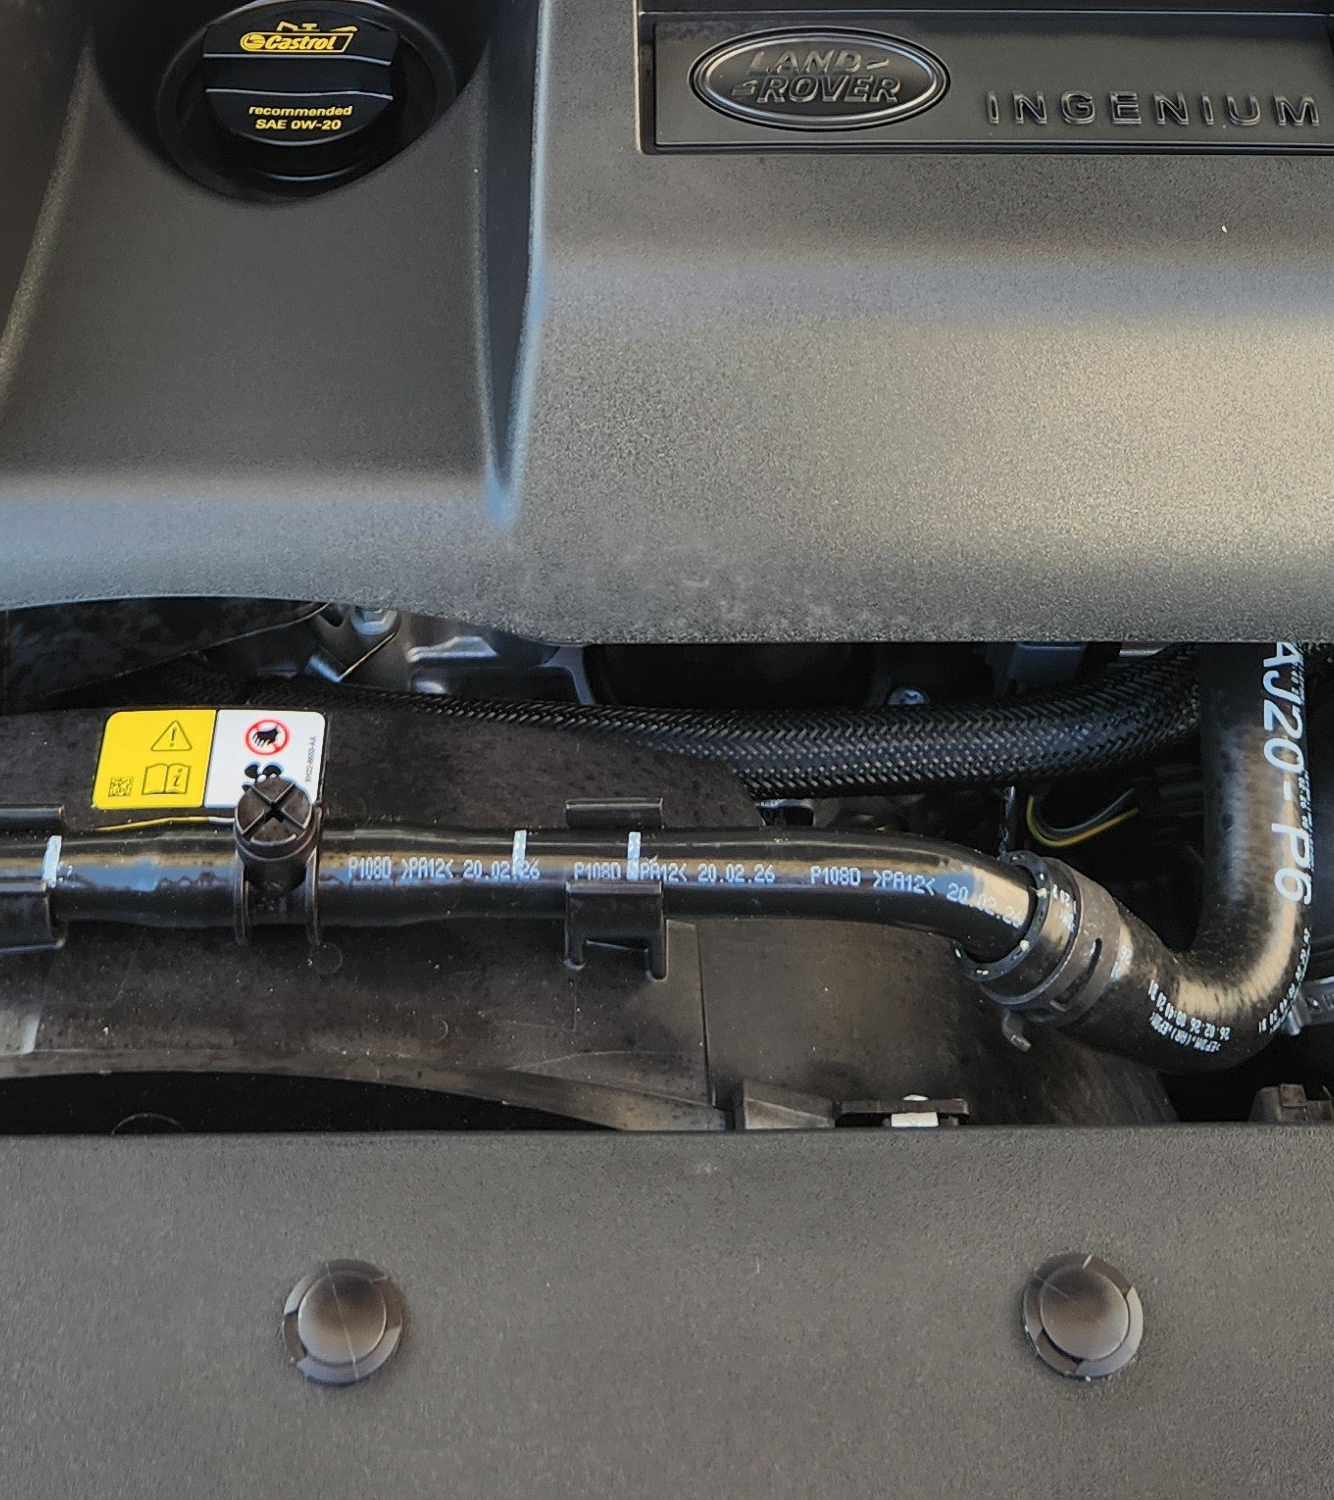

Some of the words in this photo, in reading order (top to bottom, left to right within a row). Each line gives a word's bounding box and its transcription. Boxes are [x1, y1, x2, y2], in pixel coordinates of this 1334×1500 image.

[264, 34, 336, 50] Castrol
[749, 49, 867, 74] LAND
[757, 74, 902, 104] ROVER
[248, 104, 353, 118] recommended
[986, 90, 1322, 128] INGENIUM
[255, 119, 288, 131] SAE
[290, 119, 342, 131] 0W-20
[697, 863, 776, 885] 20.02.26
